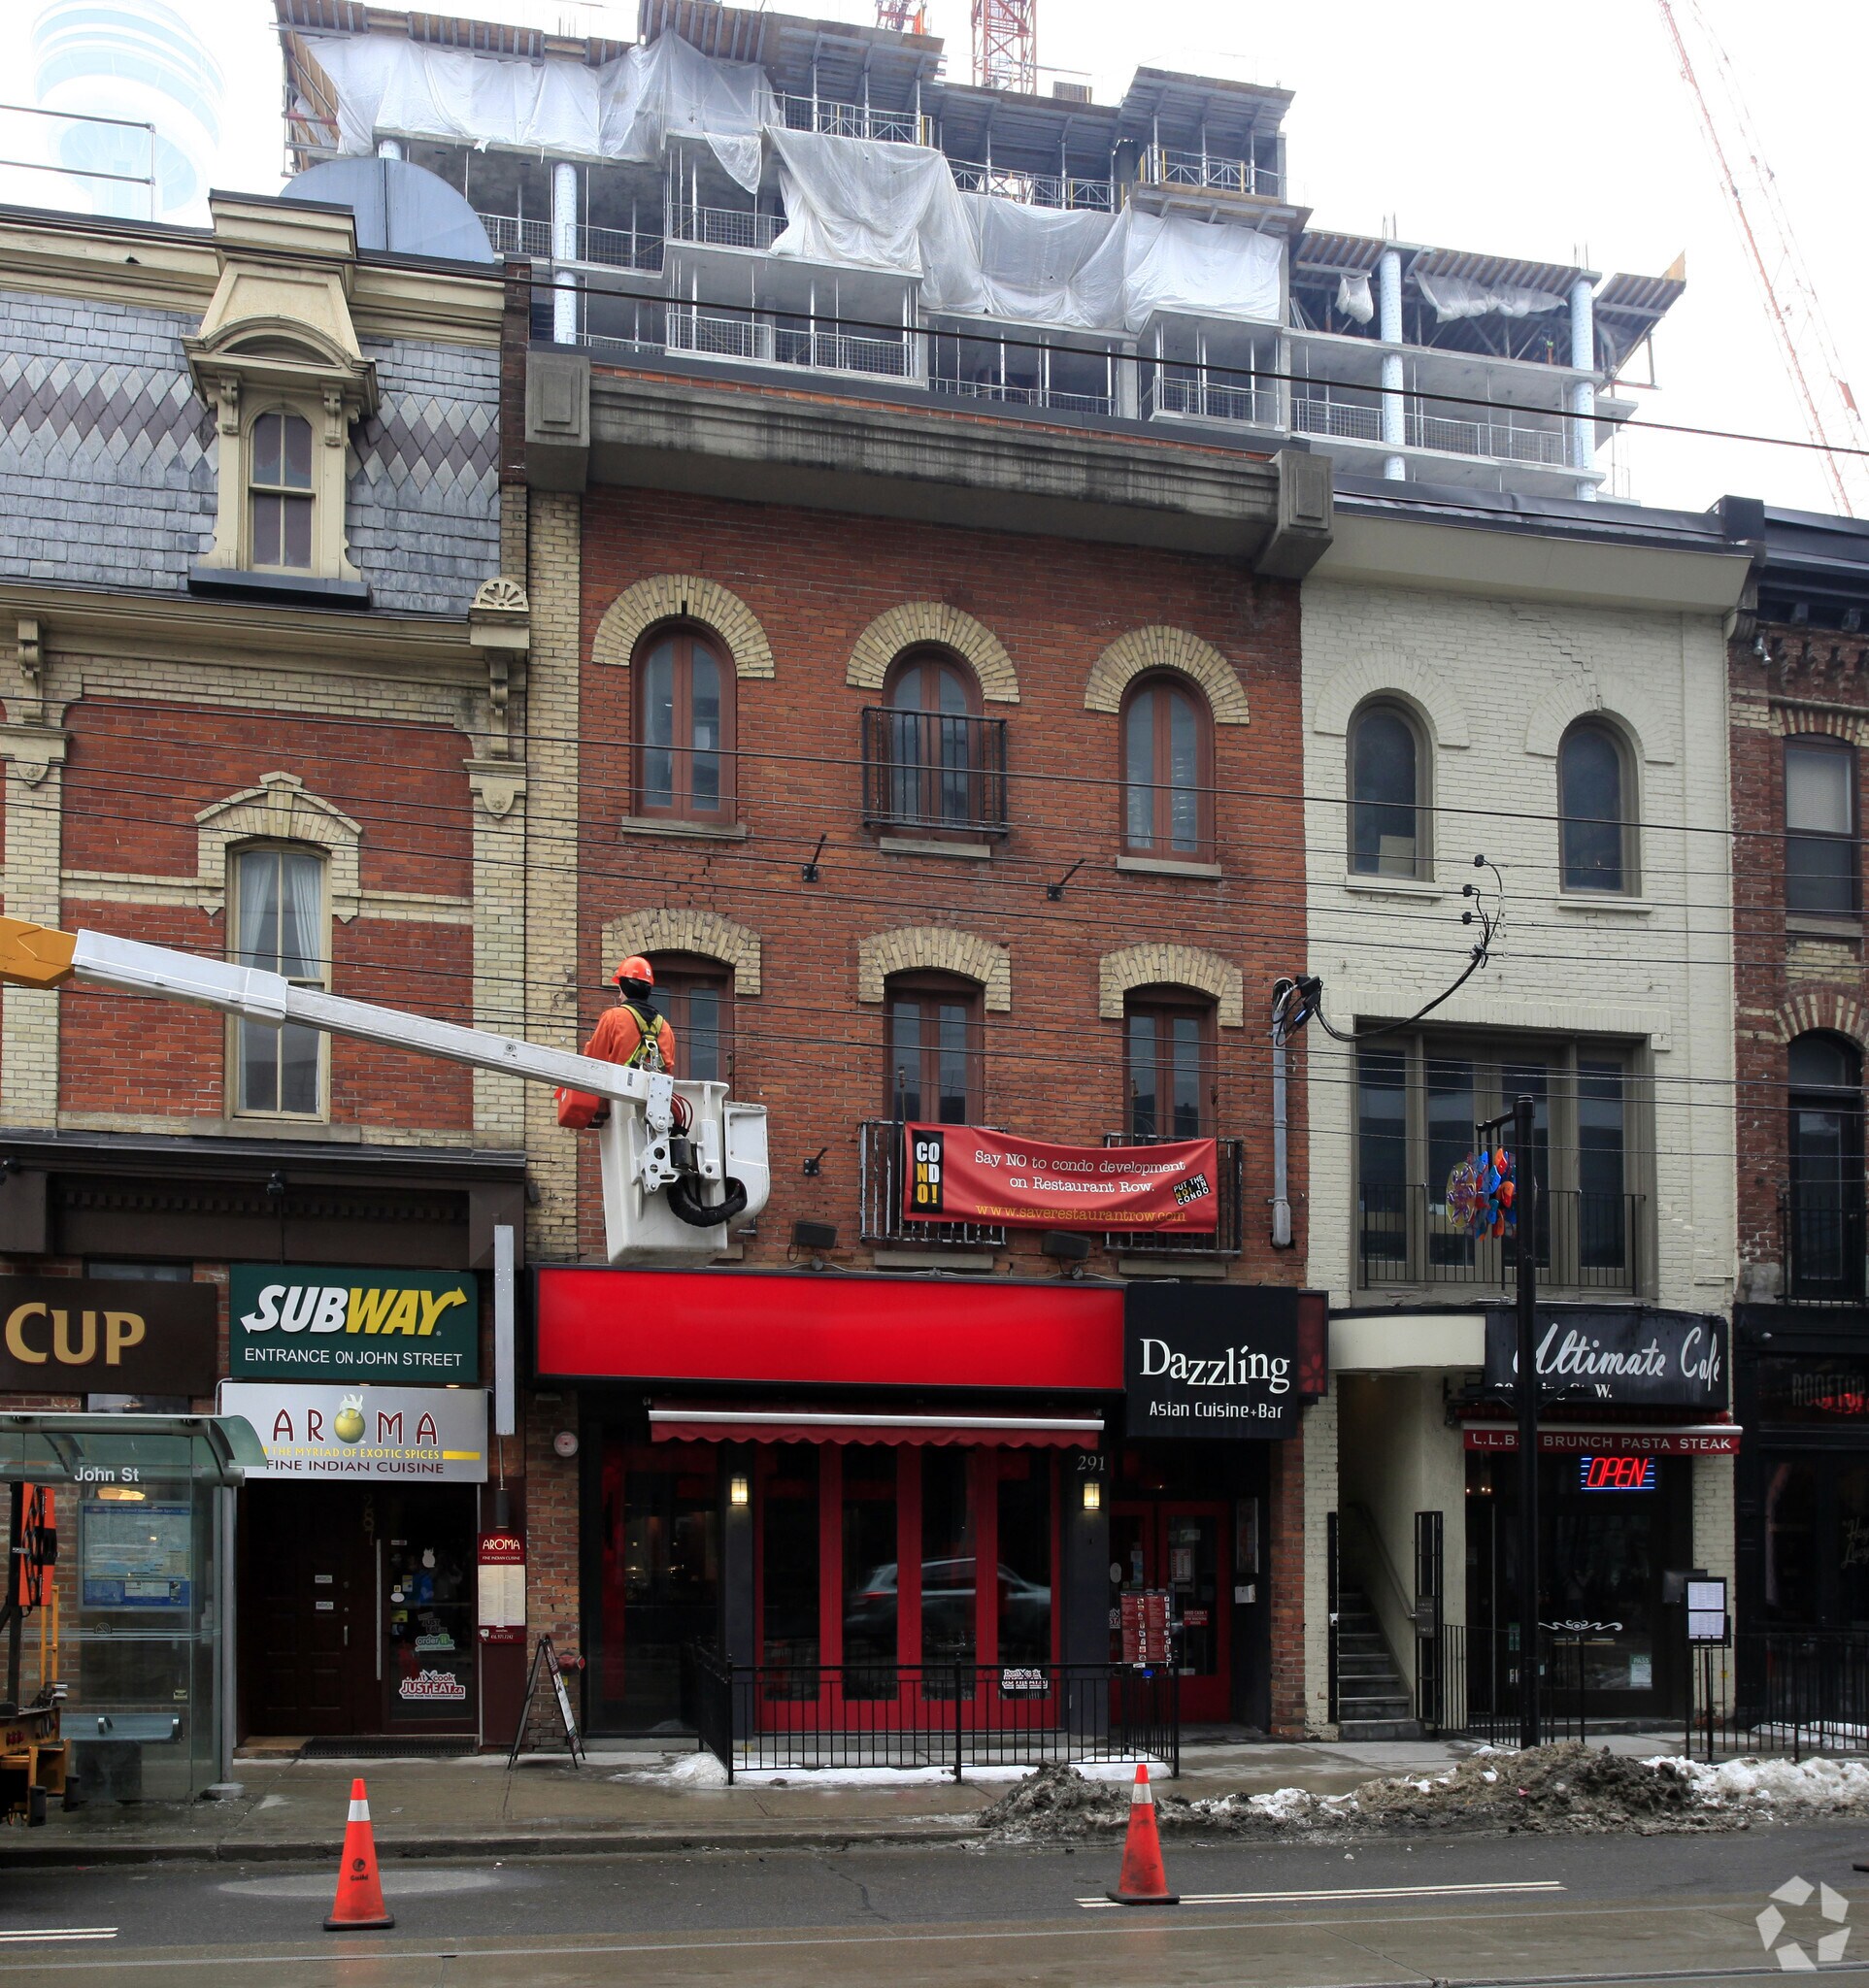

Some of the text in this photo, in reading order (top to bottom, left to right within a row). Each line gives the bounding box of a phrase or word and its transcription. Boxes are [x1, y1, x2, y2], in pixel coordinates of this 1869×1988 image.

[975, 1150, 1185, 1176] Say NO to condo development
[1009, 1176, 1155, 1193] on Restaurant Row.
[1173, 1174, 1205, 1193] PUT THE
[1196, 1179, 1207, 1190] IN
[1177, 1186, 1210, 1206] CONDO
[975, 1204, 1186, 1223] www.saverestaurantrow.com
[240, 1284, 468, 1336] SUBWAY
[5, 1302, 146, 1366] CUP
[245, 1347, 463, 1367] ENTRANCE ON JOHN STREET
[1150, 1401, 1189, 1417] Asian
[1543, 1436, 1613, 1448] BRUNCH
[1621, 1437, 1671, 1449] PASTA
[1679, 1438, 1732, 1449] STEAK
[272, 1445, 440, 1460] THE MYRIAD OF EXOTIC SPICES
[266, 1459, 444, 1474] FINE INDIAN CUISINE
[1077, 1455, 1105, 1472] 291
[1586, 1457, 1649, 1487] OPEN
[74, 1467, 140, 1482] John St
[482, 1539, 520, 1550] AROMA
[402, 1682, 430, 1693] JUST
